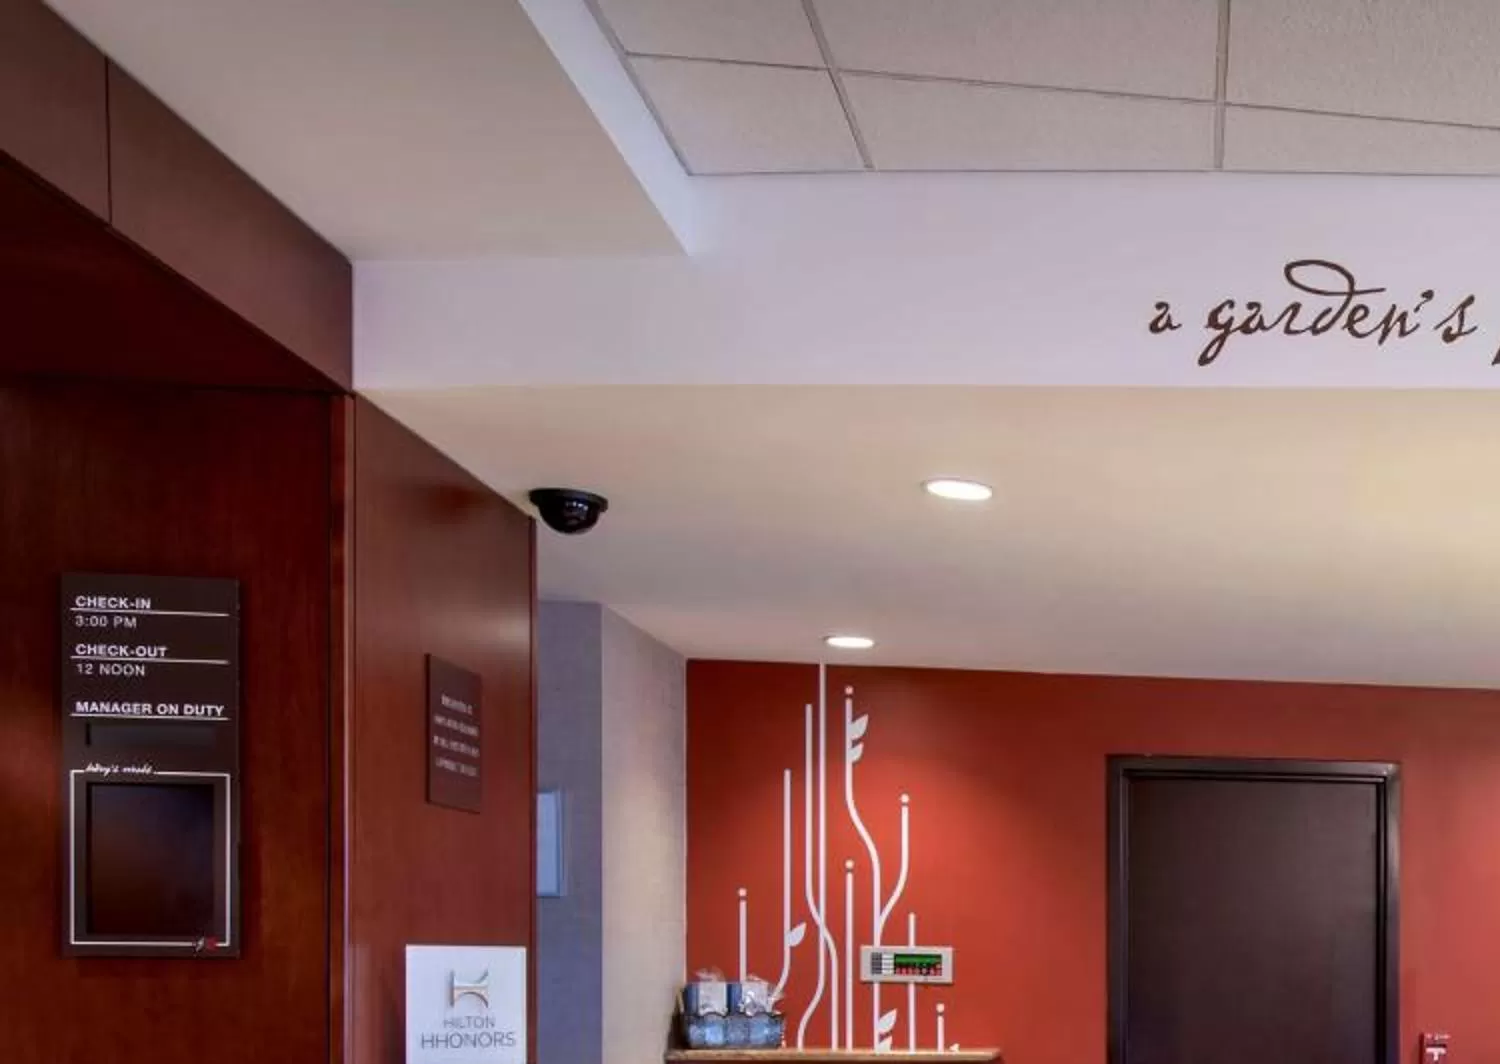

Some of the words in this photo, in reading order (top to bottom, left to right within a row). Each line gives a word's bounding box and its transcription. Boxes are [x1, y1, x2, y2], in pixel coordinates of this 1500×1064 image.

[1148, 301, 1183, 335] a
[1197, 259, 1478, 367] garden's
[75, 595, 151, 609] CHECK-IN
[75, 615, 108, 628] 3:00
[113, 615, 137, 628] PM
[75, 643, 167, 657] CHECK-OUT
[77, 663, 93, 675] 12
[99, 663, 145, 676] NOON
[75, 701, 152, 714] MANAGER
[156, 703, 179, 715] ON
[183, 704, 225, 717] DUTY
[443, 1015, 496, 1030] HILTON
[420, 1031, 517, 1050] HHONORS
